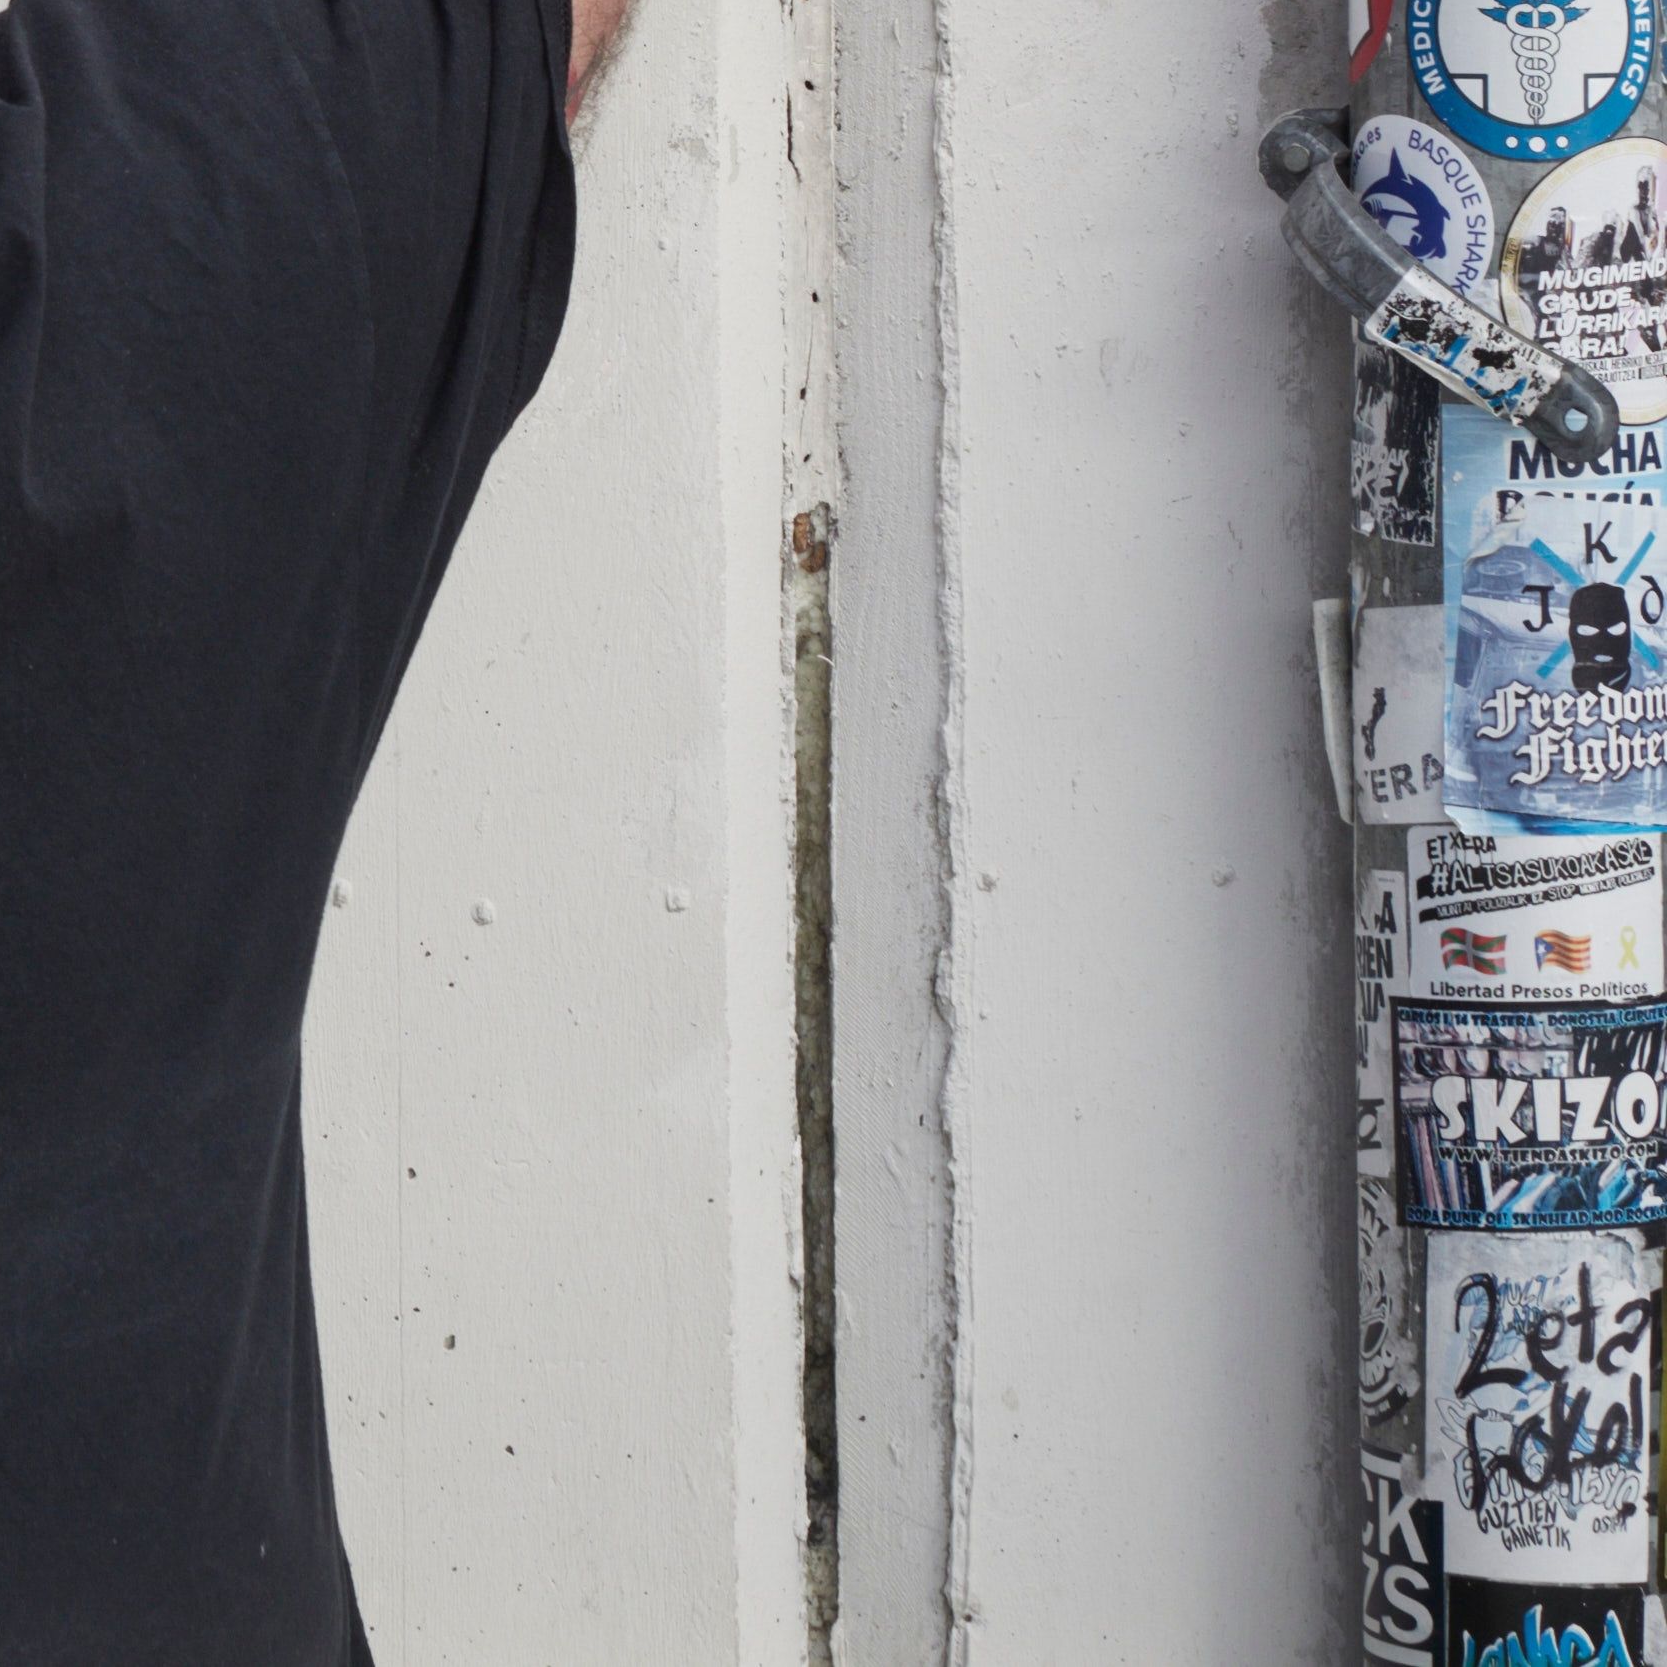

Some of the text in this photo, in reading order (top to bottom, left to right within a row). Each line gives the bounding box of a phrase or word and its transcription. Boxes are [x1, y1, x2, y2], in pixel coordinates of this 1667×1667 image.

[1407, 129, 1487, 297] BASQUE SHARK
[1583, 521, 1618, 565] K
[1547, 885, 1576, 902] STOP
[1430, 979, 1648, 999] Libertad Presos Políticos
[1471, 1011, 1536, 1027] TRASERA
[1547, 1009, 1617, 1028] DONOSTIA
[1431, 1069, 1660, 1145] SKIZO
[1406, 1206, 1440, 1225] ROPA
[1441, 1209, 1483, 1226] PUNK
[1512, 1210, 1589, 1226] SKINHEAD
[1592, 1208, 1624, 1225] MOD
